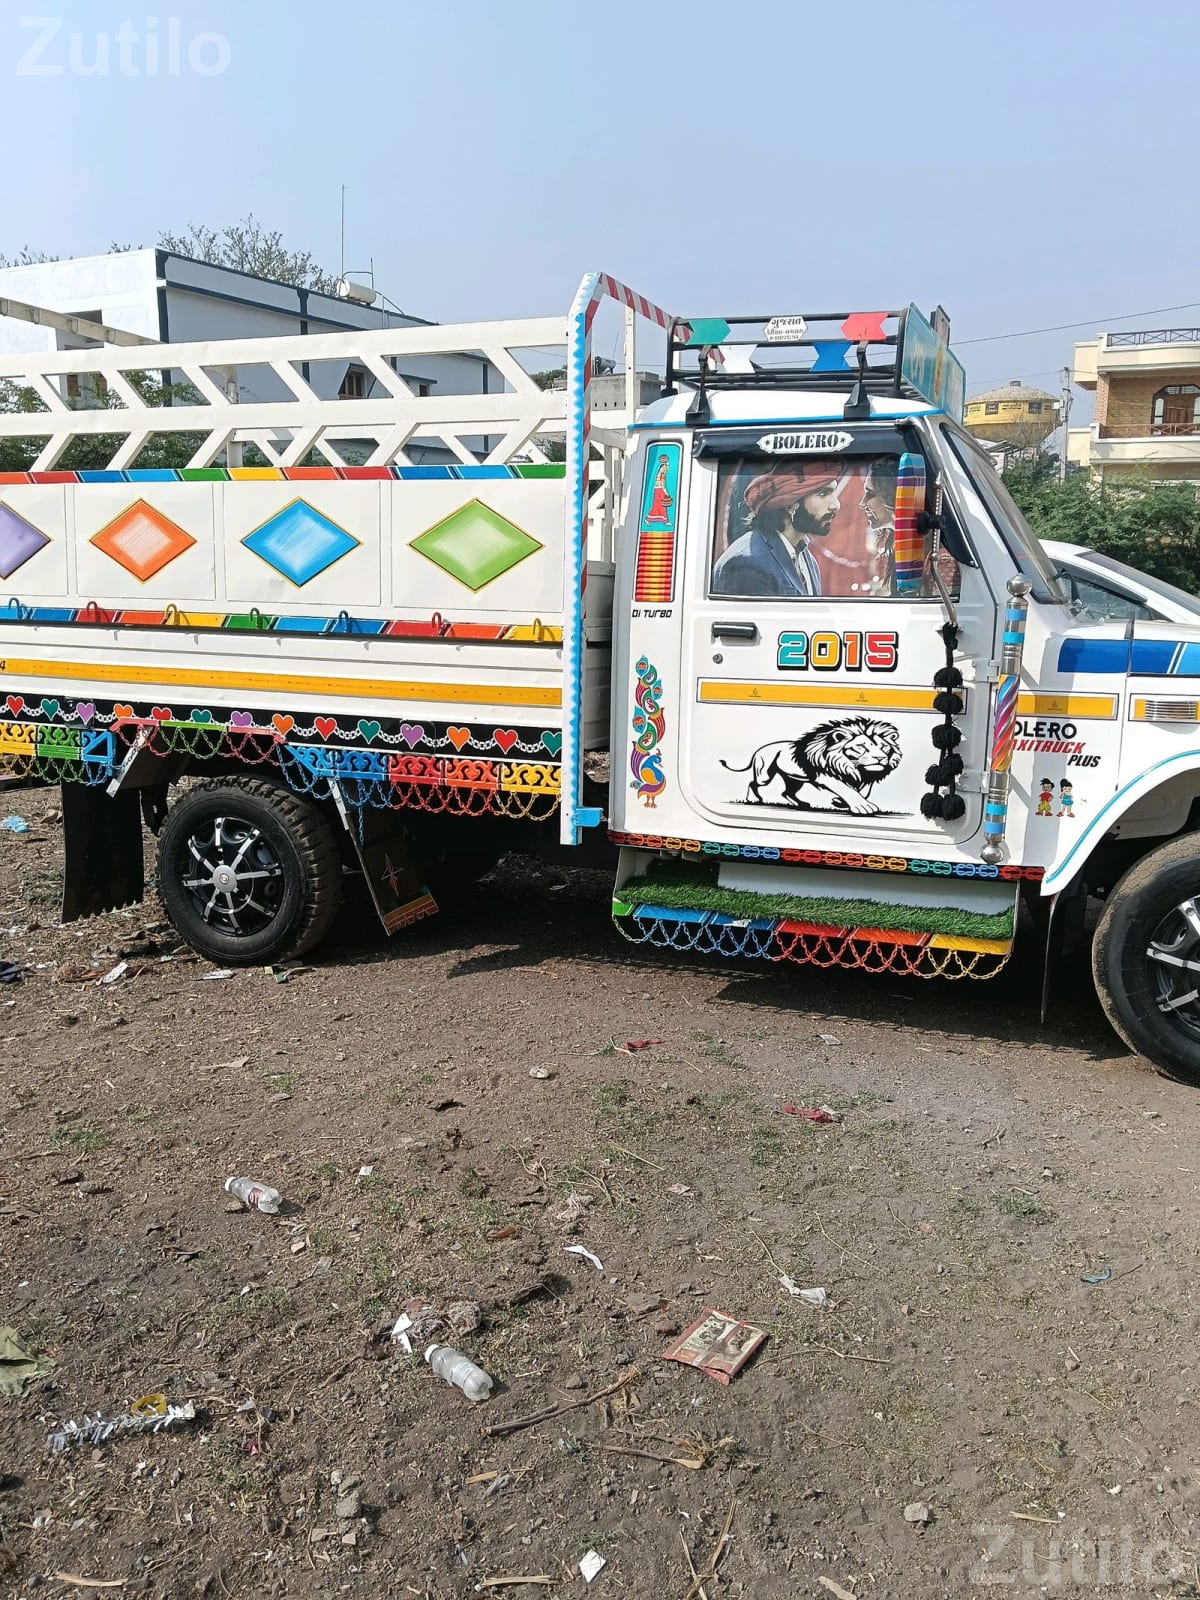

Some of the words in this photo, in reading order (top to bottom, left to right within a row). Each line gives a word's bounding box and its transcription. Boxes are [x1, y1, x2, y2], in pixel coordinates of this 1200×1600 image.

[771, 318, 802, 329] ગુજરાત
[773, 434, 839, 449] BOLERO
[777, 631, 899, 672] 2015
[1014, 720, 1078, 741] OLERO
[1067, 754, 1102, 768] PLUS
